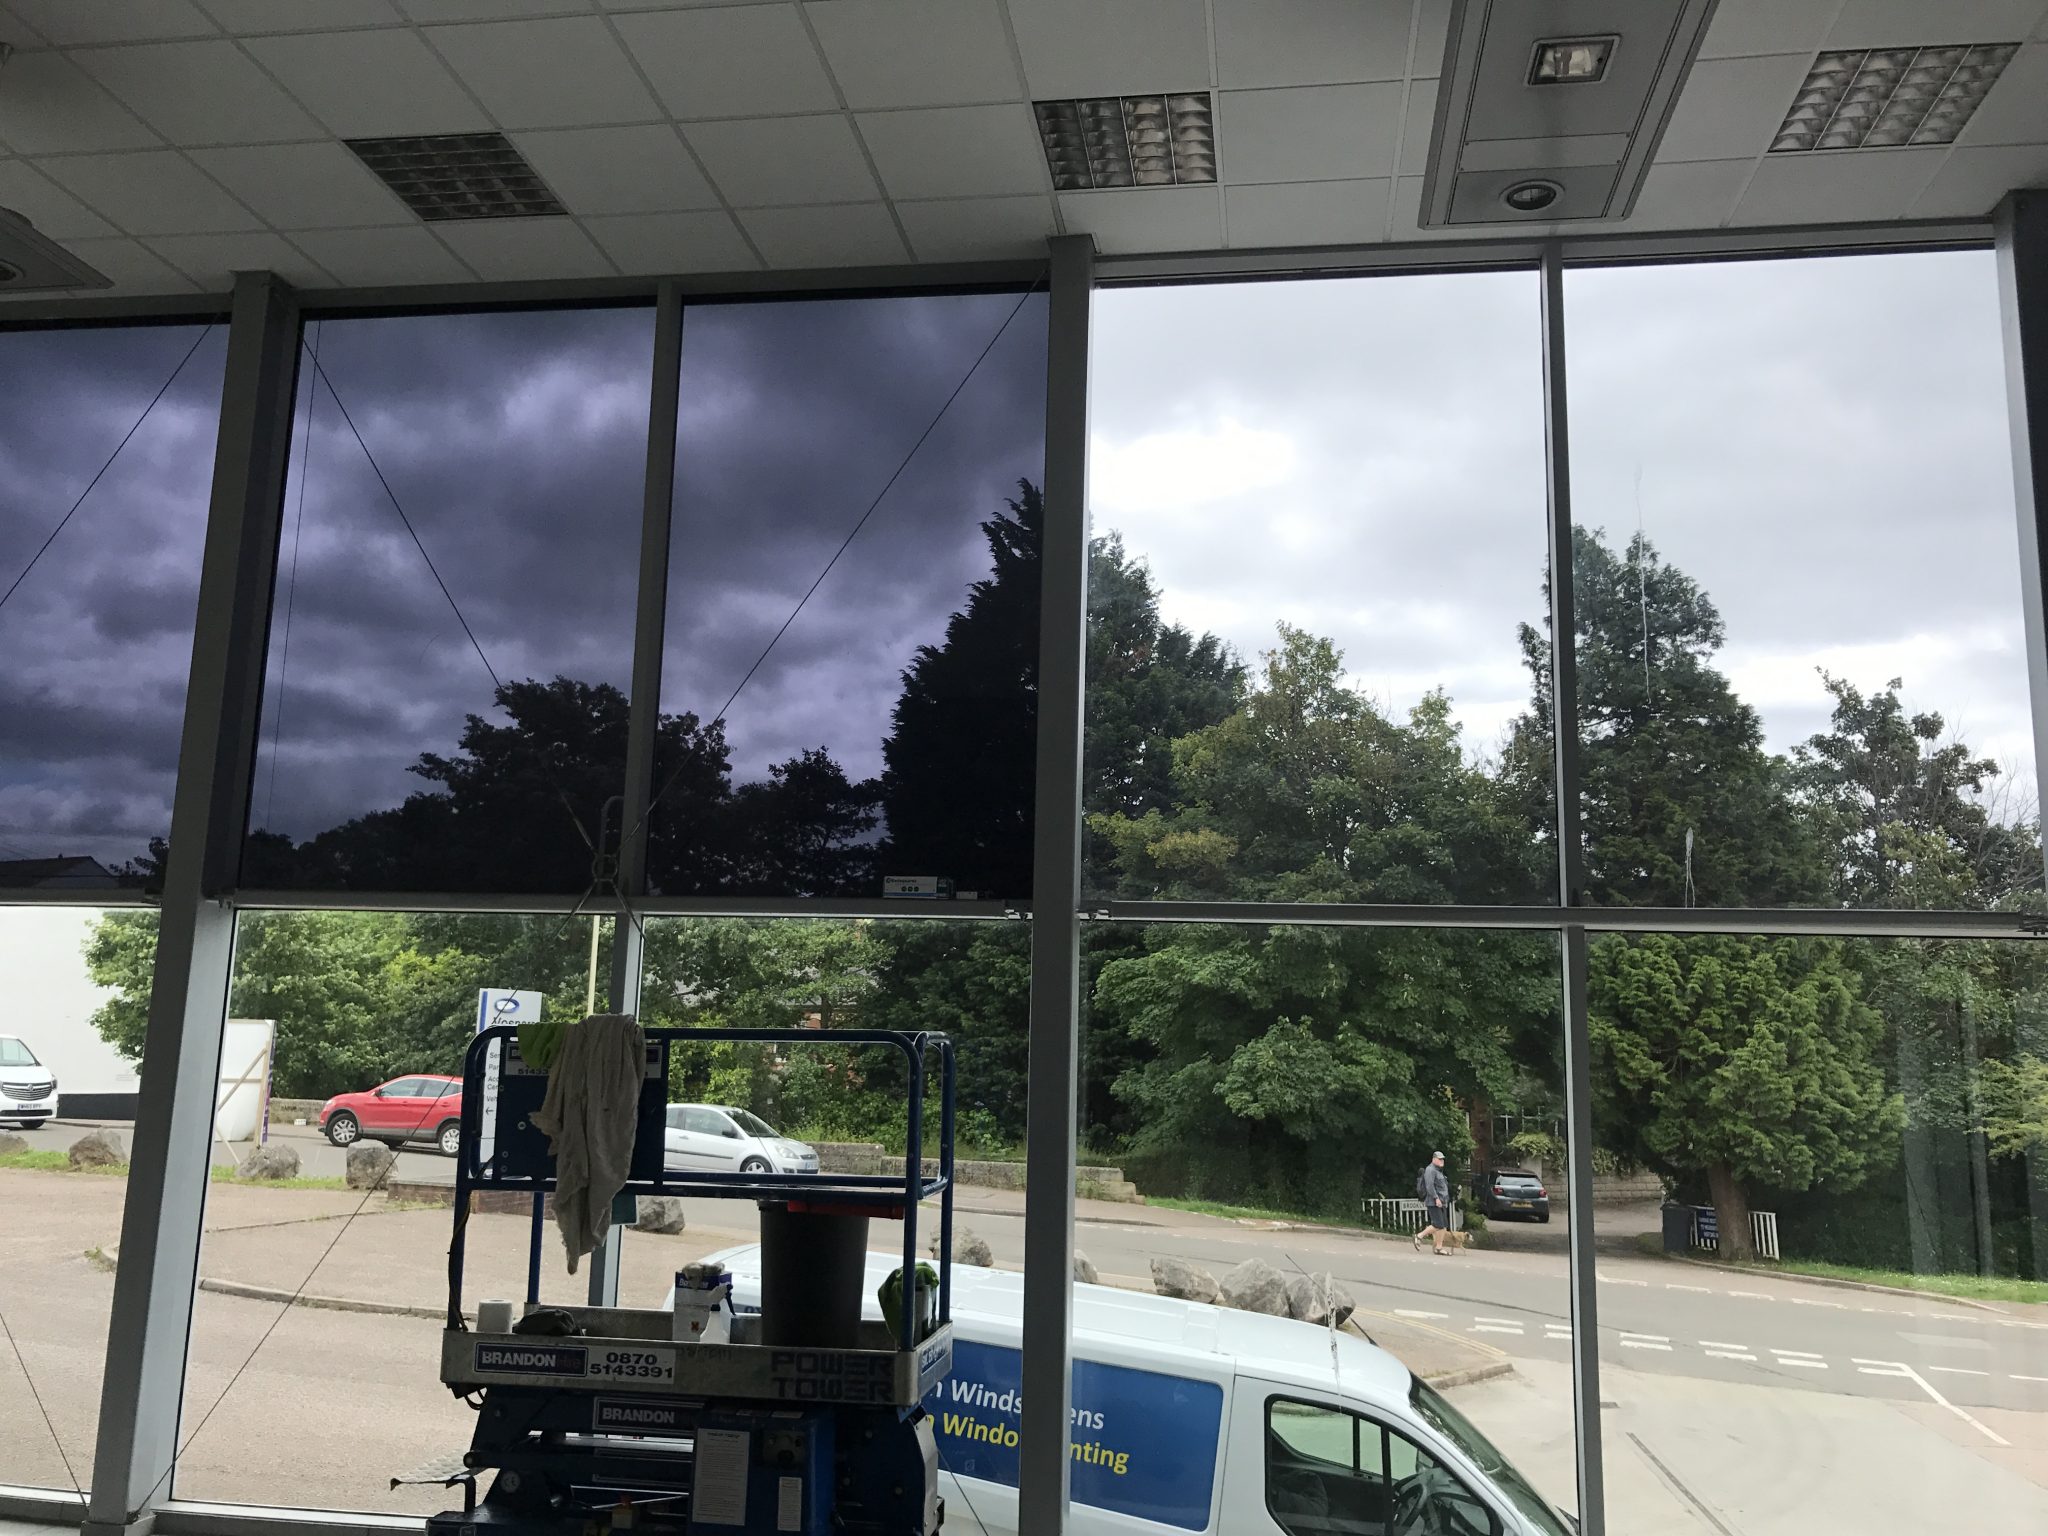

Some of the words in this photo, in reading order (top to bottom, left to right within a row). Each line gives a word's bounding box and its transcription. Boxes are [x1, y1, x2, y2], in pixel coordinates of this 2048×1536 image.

[518, 1068, 549, 1076] 51433
[481, 1351, 556, 1368] BRANDON
[606, 1351, 658, 1366] 0870
[770, 1351, 895, 1376] POWER
[589, 1363, 674, 1379] 5143391
[772, 1377, 894, 1400] TOWER
[602, 1407, 675, 1424] BRANDON
[943, 1412, 1019, 1448] Windo
[1070, 1441, 1130, 1475] nting
